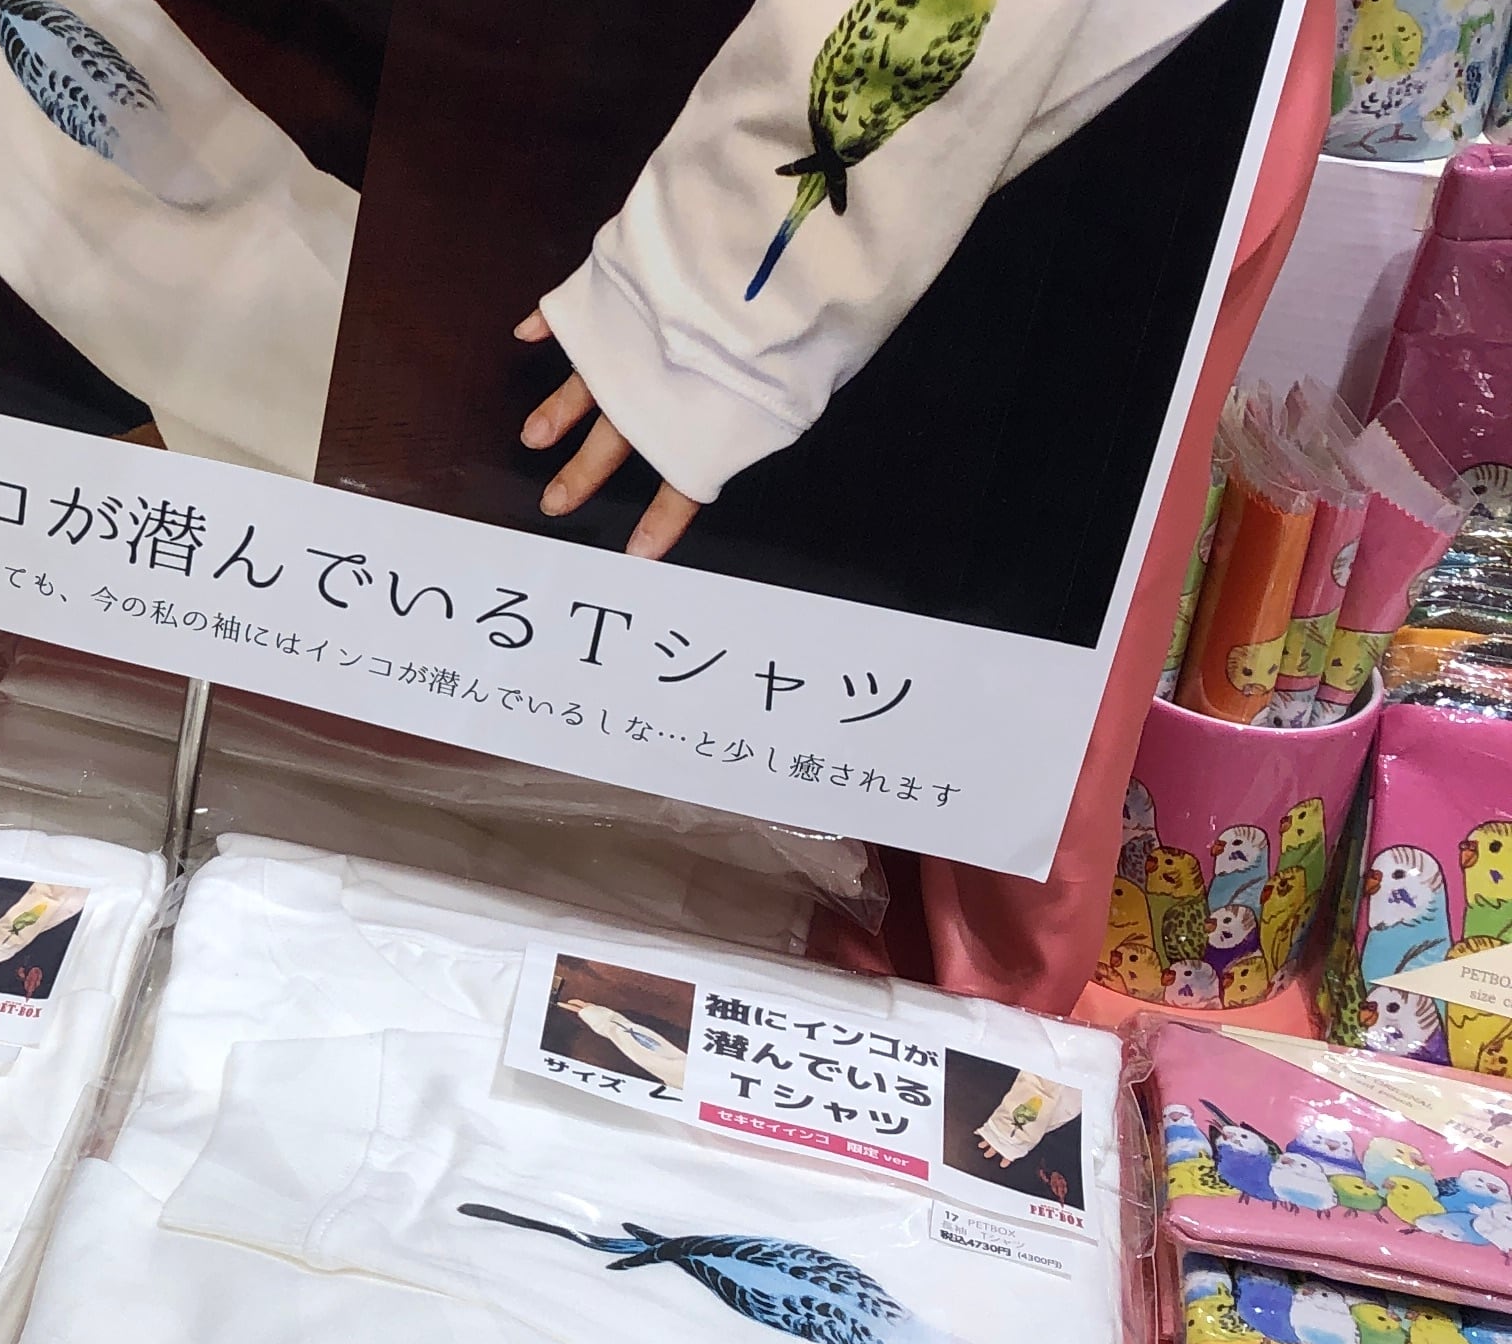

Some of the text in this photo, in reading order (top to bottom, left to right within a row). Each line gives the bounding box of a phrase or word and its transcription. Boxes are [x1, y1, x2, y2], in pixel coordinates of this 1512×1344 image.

[1460, 966, 1512, 989] PETBO
[1470, 989, 1496, 1004] size
[705, 993, 940, 1069] 袖にインコが
[544, 1057, 627, 1094] サイズ
[702, 1027, 932, 1108] 潜んでいる
[730, 1072, 910, 1135] Tシャツ
[718, 1109, 910, 1167] セキセイインコ 限定 ver
[945, 1211, 1016, 1237] 17 PETBOX
[1030, 1205, 1084, 1229] PET-BOX
[1018, 1252, 1063, 1270] (4300円)
